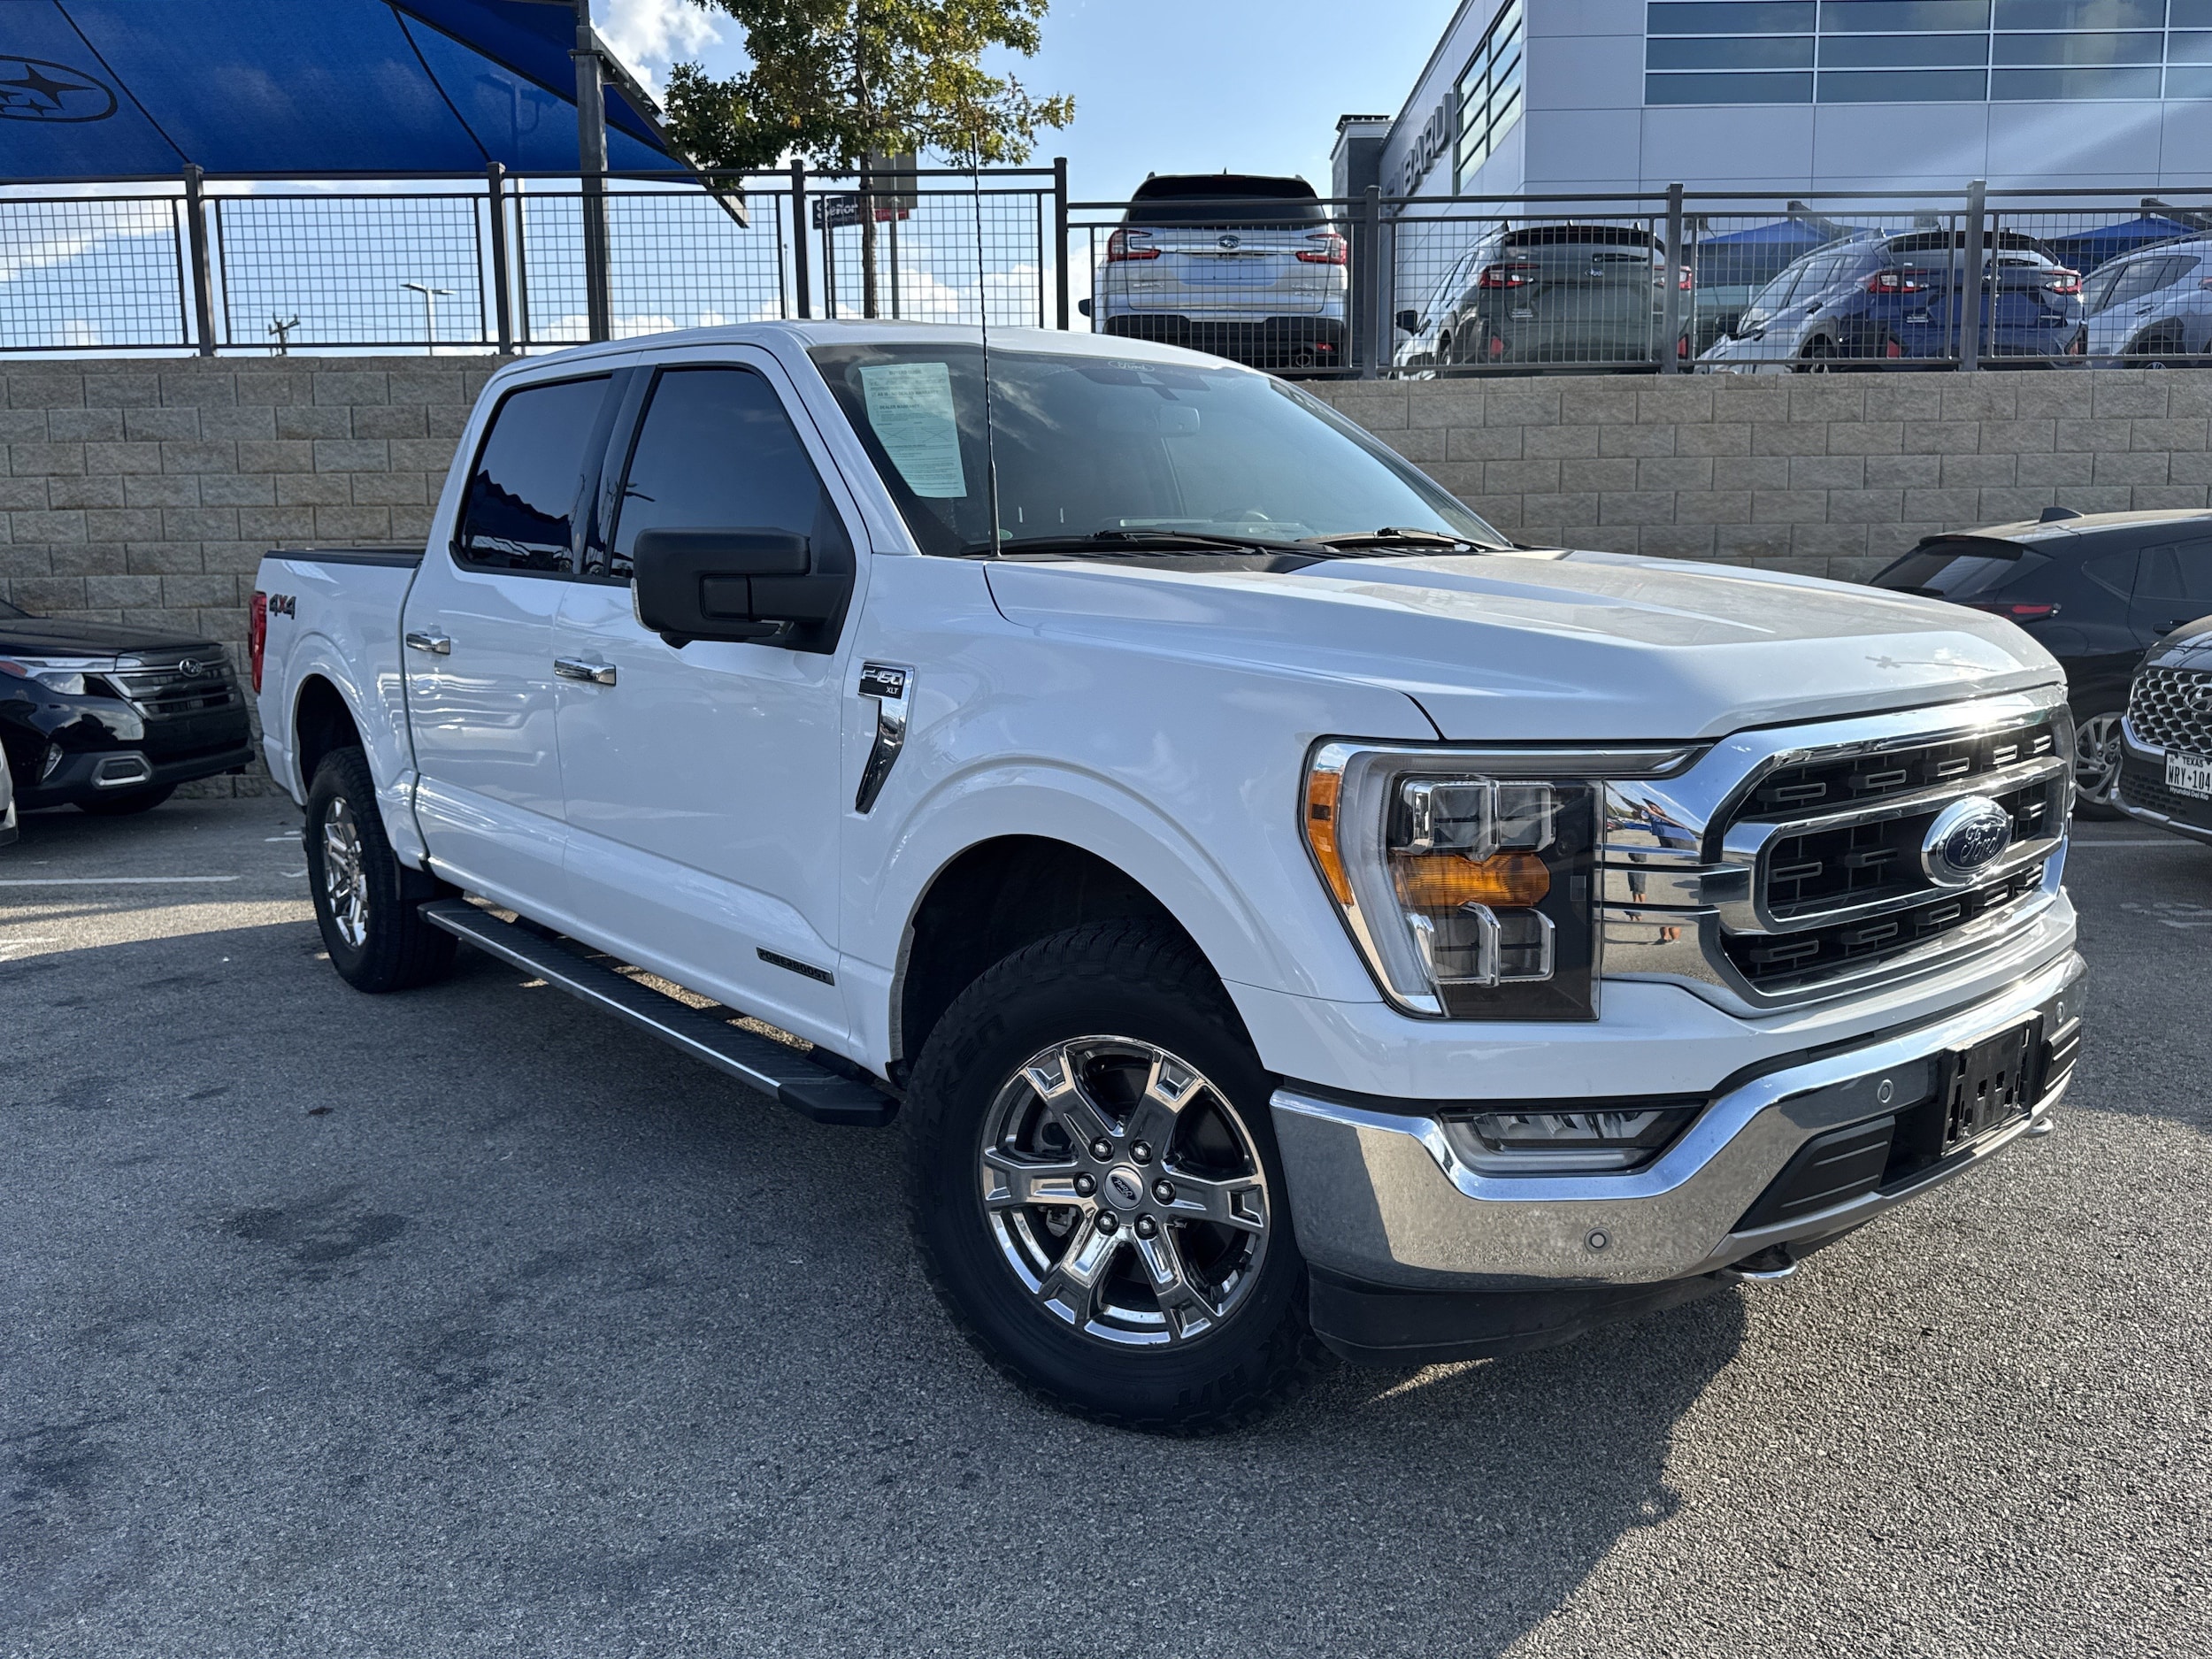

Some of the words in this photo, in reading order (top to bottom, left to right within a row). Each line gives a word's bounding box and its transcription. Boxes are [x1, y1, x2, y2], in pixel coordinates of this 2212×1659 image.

[886, 686, 899, 695] XLT
[2182, 757, 2203, 768] TEXAS
[2169, 785, 2191, 797] Hyundai
[2191, 789, 2200, 799] Del
[2200, 792, 2209, 801] Rio
[758, 949, 828, 980] POWERBOOST
[1113, 1179, 1133, 1197] Ford
